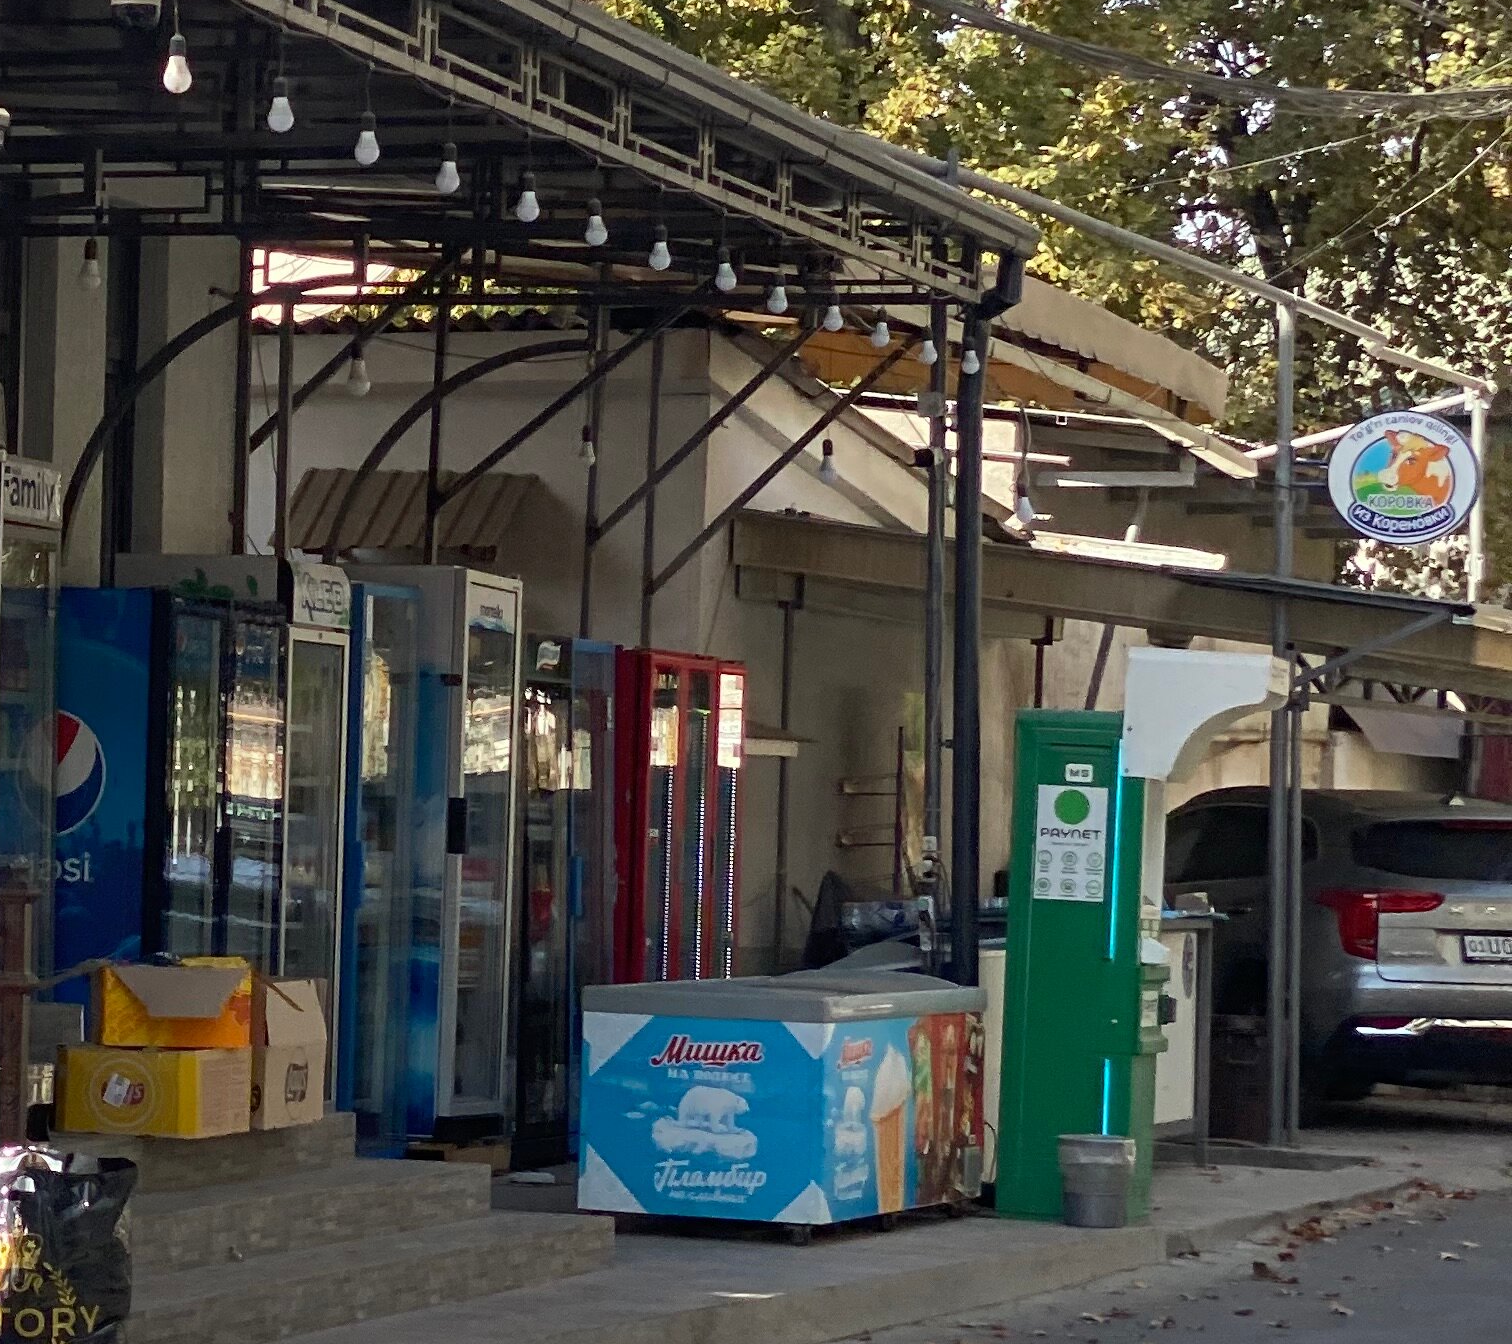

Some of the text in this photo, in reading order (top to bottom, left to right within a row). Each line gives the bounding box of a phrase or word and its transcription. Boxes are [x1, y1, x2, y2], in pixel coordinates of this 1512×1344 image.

[1368, 495, 1433, 509] КОРОВКА
[1040, 827, 1102, 841] PAYNET
[650, 1034, 764, 1067] Мишка
